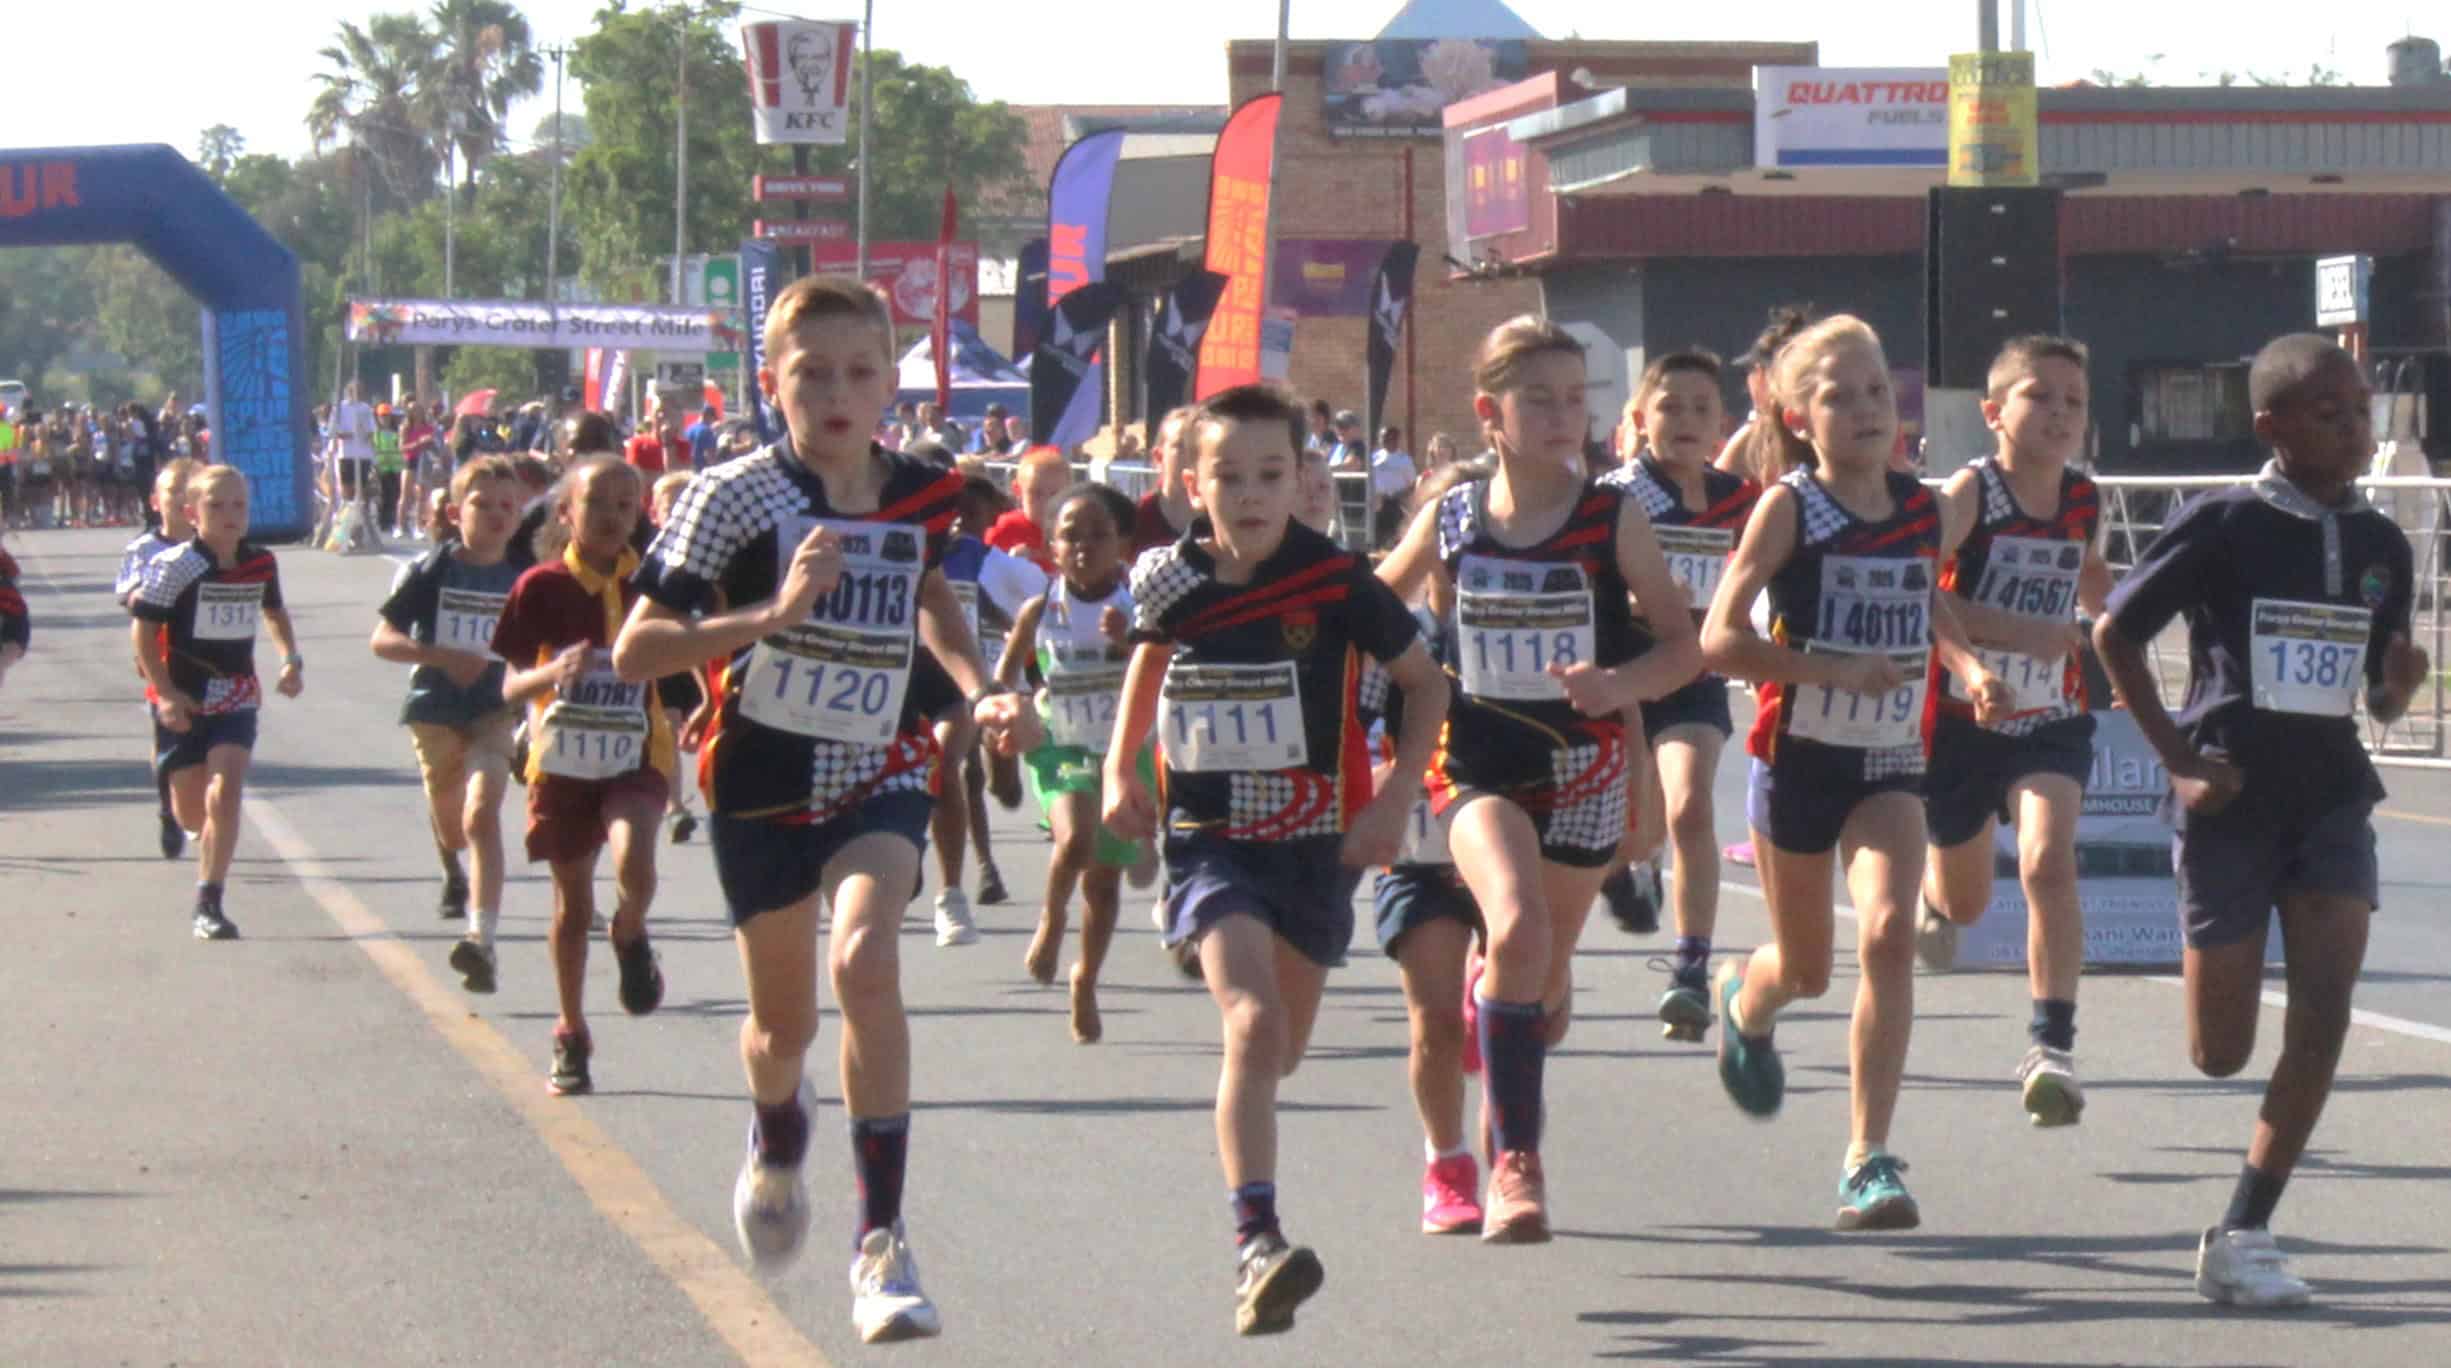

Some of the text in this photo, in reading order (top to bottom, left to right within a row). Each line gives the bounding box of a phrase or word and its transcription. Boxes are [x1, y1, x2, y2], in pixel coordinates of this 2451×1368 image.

[1786, 81, 1949, 104] QUATTRO
[785, 112, 835, 129] KFC
[1048, 224, 1091, 309] UR
[412, 311, 706, 338] Parys Crater Street Mile
[1845, 602, 1922, 646] 40112
[1473, 631, 1577, 673] 1118
[2268, 641, 2358, 687] 1387
[772, 658, 889, 715] 1120
[1061, 694, 1116, 724] 112
[1171, 702, 1277, 745] 1111
[558, 729, 632, 761] 1110
[2088, 745, 2161, 787] llar
